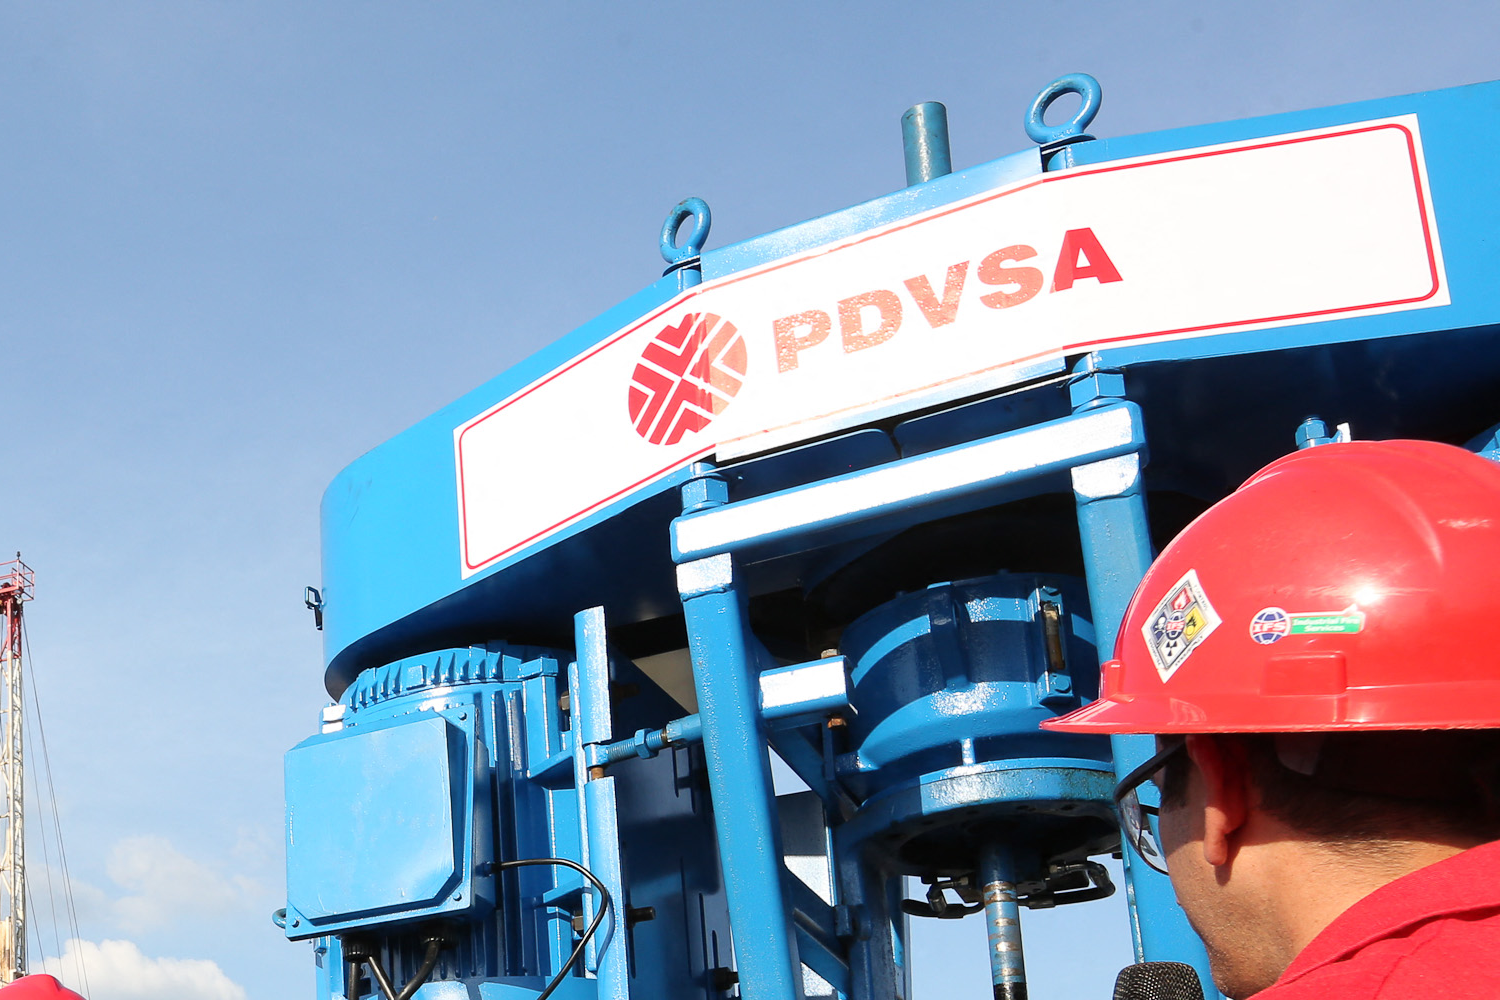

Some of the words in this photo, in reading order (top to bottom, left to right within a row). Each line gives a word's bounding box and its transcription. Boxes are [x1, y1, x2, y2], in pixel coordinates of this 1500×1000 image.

[772, 227, 1124, 374] PDVSA
[1166, 620, 1185, 631] IFS
[1252, 621, 1286, 632] IFS
[1292, 616, 1340, 626] Industrial
[1304, 624, 1346, 633] Services
